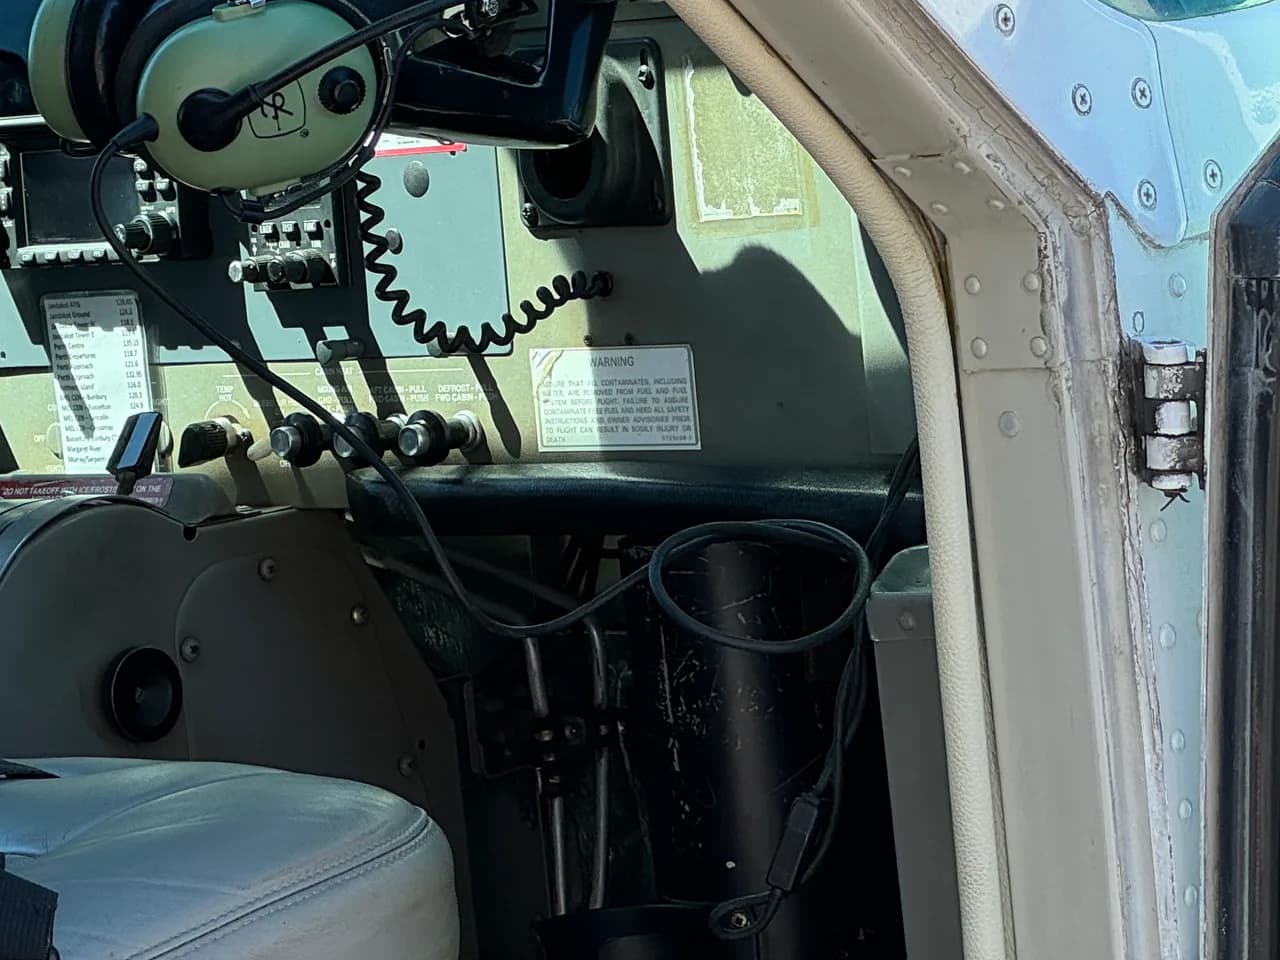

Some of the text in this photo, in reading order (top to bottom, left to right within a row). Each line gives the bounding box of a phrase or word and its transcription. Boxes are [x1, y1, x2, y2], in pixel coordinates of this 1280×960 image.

[590, 356, 634, 368] WARNING
[654, 377, 687, 385] INCLUDING
[409, 384, 426, 393] PULL
[438, 384, 469, 392] DEFROST
[637, 386, 652, 394] FUEL
[656, 386, 669, 394] AND
[672, 386, 688, 394] FUEL
[218, 394, 232, 402] HOT
[410, 393, 428, 402] PUSH
[435, 393, 450, 402] FWD
[452, 392, 474, 401] CABIN
[622, 396, 648, 405] FAILURE
[652, 396, 660, 404] TO
[664, 396, 688, 404] ASSURE
[604, 406, 619, 414] FUEL
[621, 406, 634, 414] AND
[636, 406, 652, 414] HEED
[654, 406, 664, 414] ALL
[666, 405, 690, 414] SAFETY
[607, 416, 630, 424] OWNER
[633, 416, 669, 424] ADVISORIES
[546, 426, 554, 434] TO
[556, 426, 577, 434] FLIGHT
[580, 426, 593, 434] CAN
[622, 424, 629, 432] IN
[631, 424, 653, 432] BODILY
[656, 424, 679, 432] INJURY
[682, 424, 692, 432] OR
[15, 486, 30, 495] NOT
[30, 486, 60, 495] TAKEOFF
